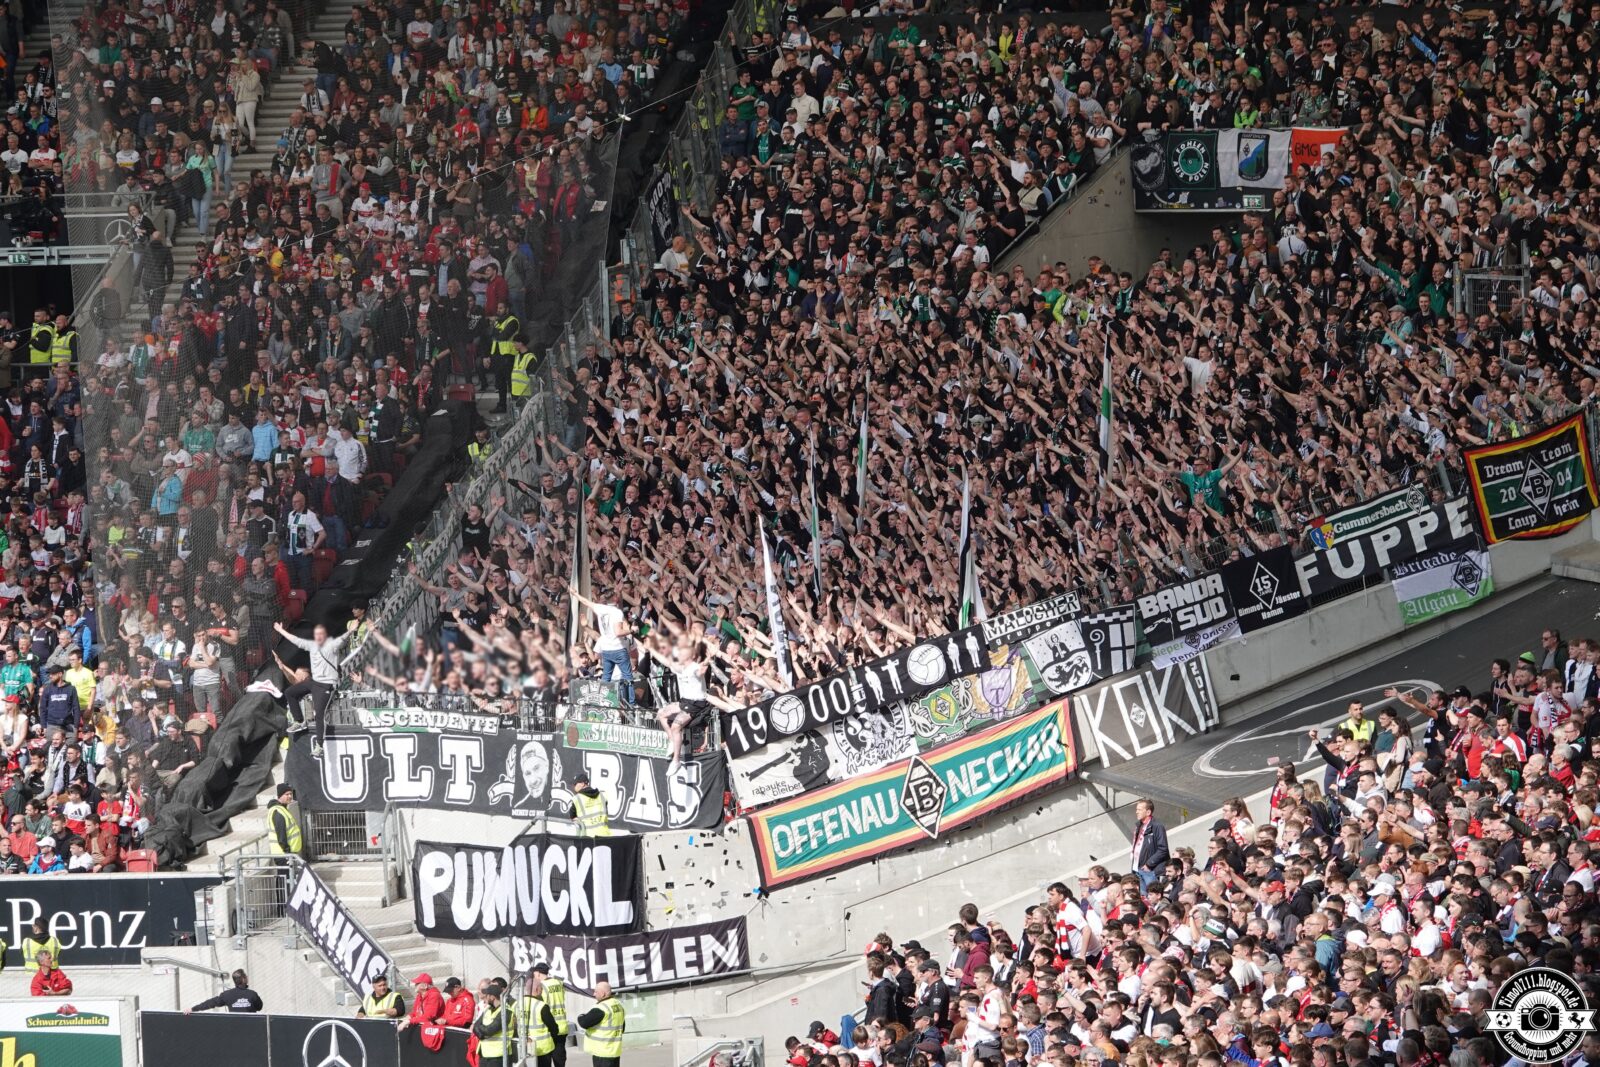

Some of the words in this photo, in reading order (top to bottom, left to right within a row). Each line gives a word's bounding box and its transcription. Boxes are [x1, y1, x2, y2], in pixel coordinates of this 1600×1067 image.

[1175, 140, 1207, 155] FOHLEN
[1294, 142, 1319, 157] BMG
[1173, 160, 1185, 178] AUS
[1188, 161, 1210, 183] POLEN
[1484, 460, 1525, 478] Dream
[1499, 486, 1518, 504] 20
[1556, 467, 1573, 486] 04
[1333, 499, 1408, 535] Gummersbach
[1295, 496, 1475, 598] FUPPE
[1392, 550, 1458, 577] Brigade
[1137, 573, 1225, 620] BANDA
[1255, 574, 1272, 592] 15
[986, 594, 1078, 638] MALOCHER
[1176, 596, 1228, 631] SUD
[1261, 607, 1284, 620] Hamm
[1403, 589, 1459, 618] Allgäu
[363, 711, 498, 734] ASCENDENTE
[729, 706, 769, 753] 19
[751, 779, 787, 796] rabauke
[772, 789, 901, 859] OFFENAU
[946, 720, 1063, 804] NECKAR
[419, 844, 633, 932] PUMUCKL
[289, 866, 388, 998] PINKIS
[27, 1017, 108, 1026] Schwarzwaldmilch
